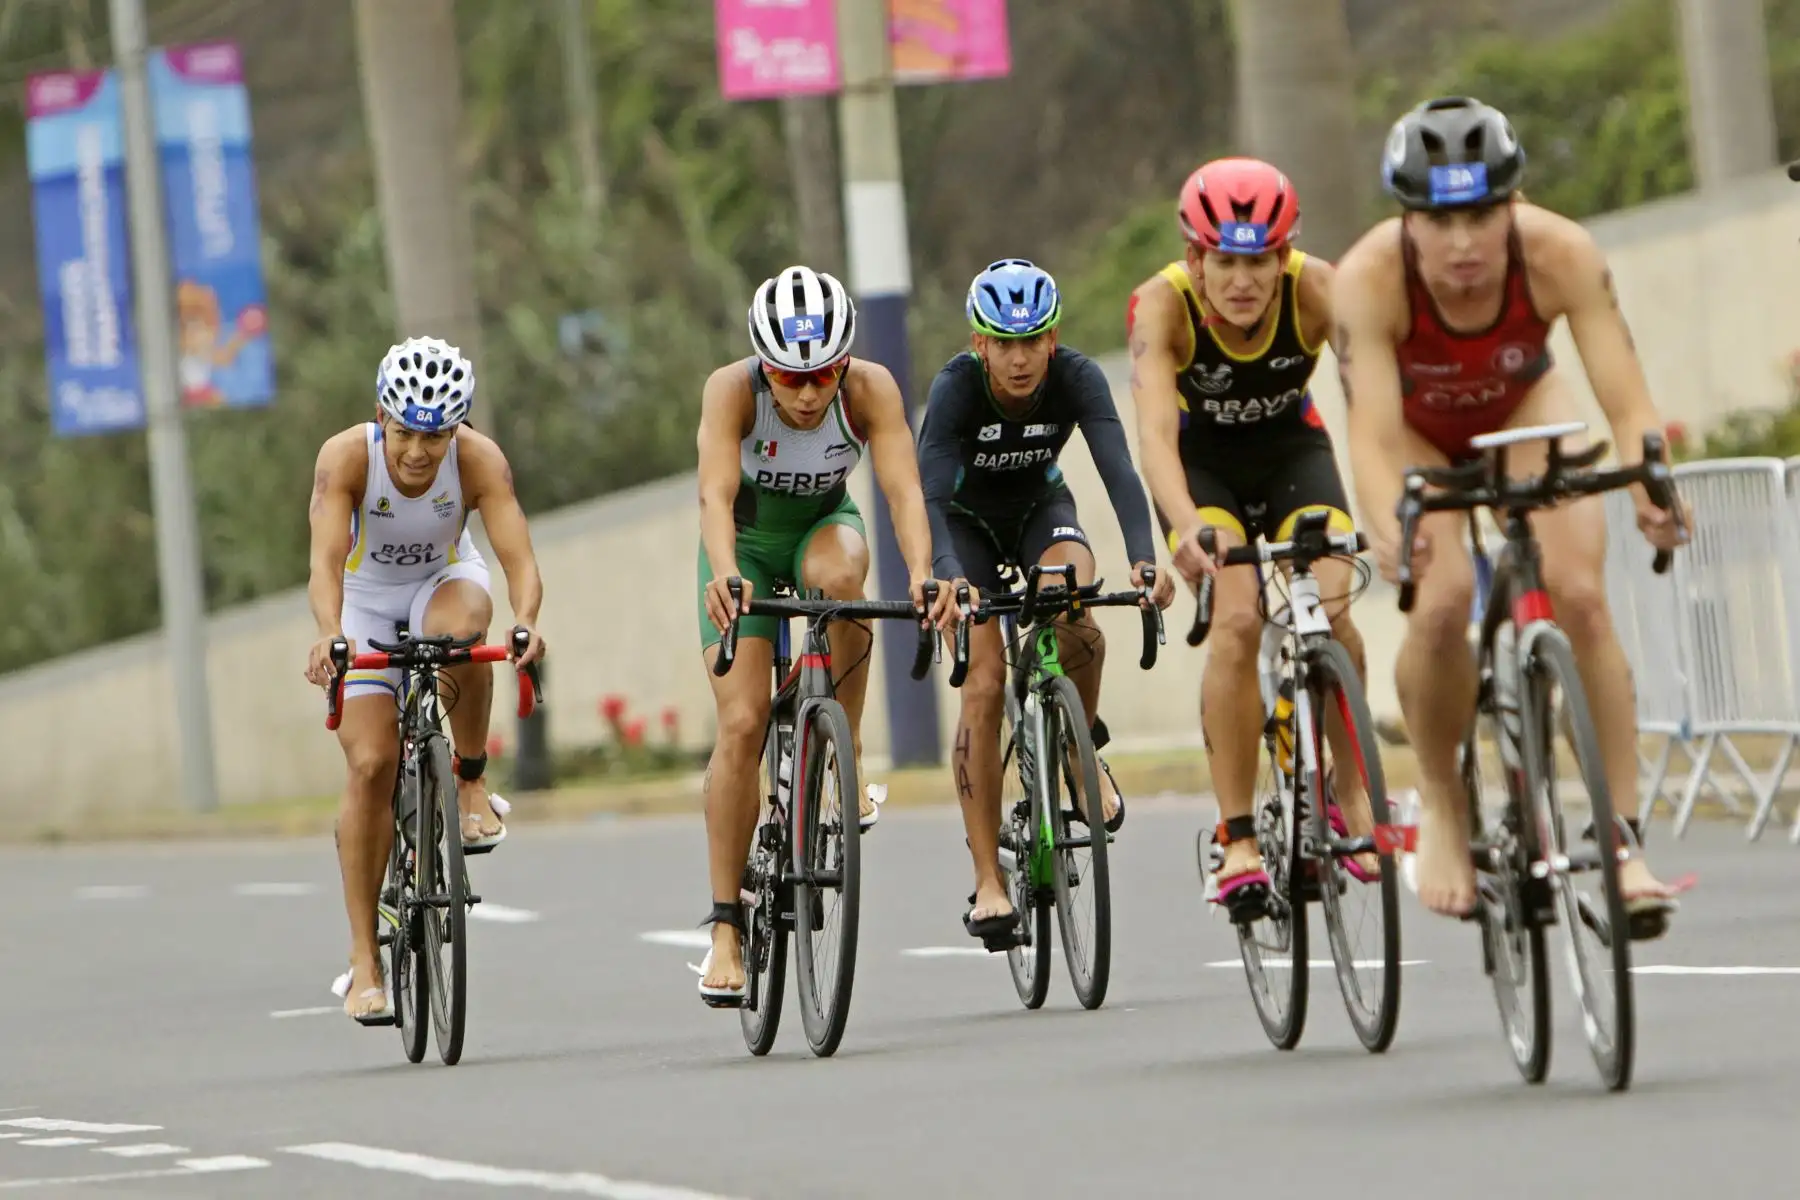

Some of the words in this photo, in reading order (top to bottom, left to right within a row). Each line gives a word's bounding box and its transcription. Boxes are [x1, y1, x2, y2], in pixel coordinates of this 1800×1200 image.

[1234, 227, 1257, 243] 6A
[1011, 306, 1030, 319] 4A
[795, 318, 815, 332] 3A
[416, 409, 433, 423] 8A
[973, 447, 1053, 469] BAPTISTA
[755, 466, 848, 490] PEREZ
[380, 542, 435, 555] RAGA
[369, 550, 444, 567] COL
